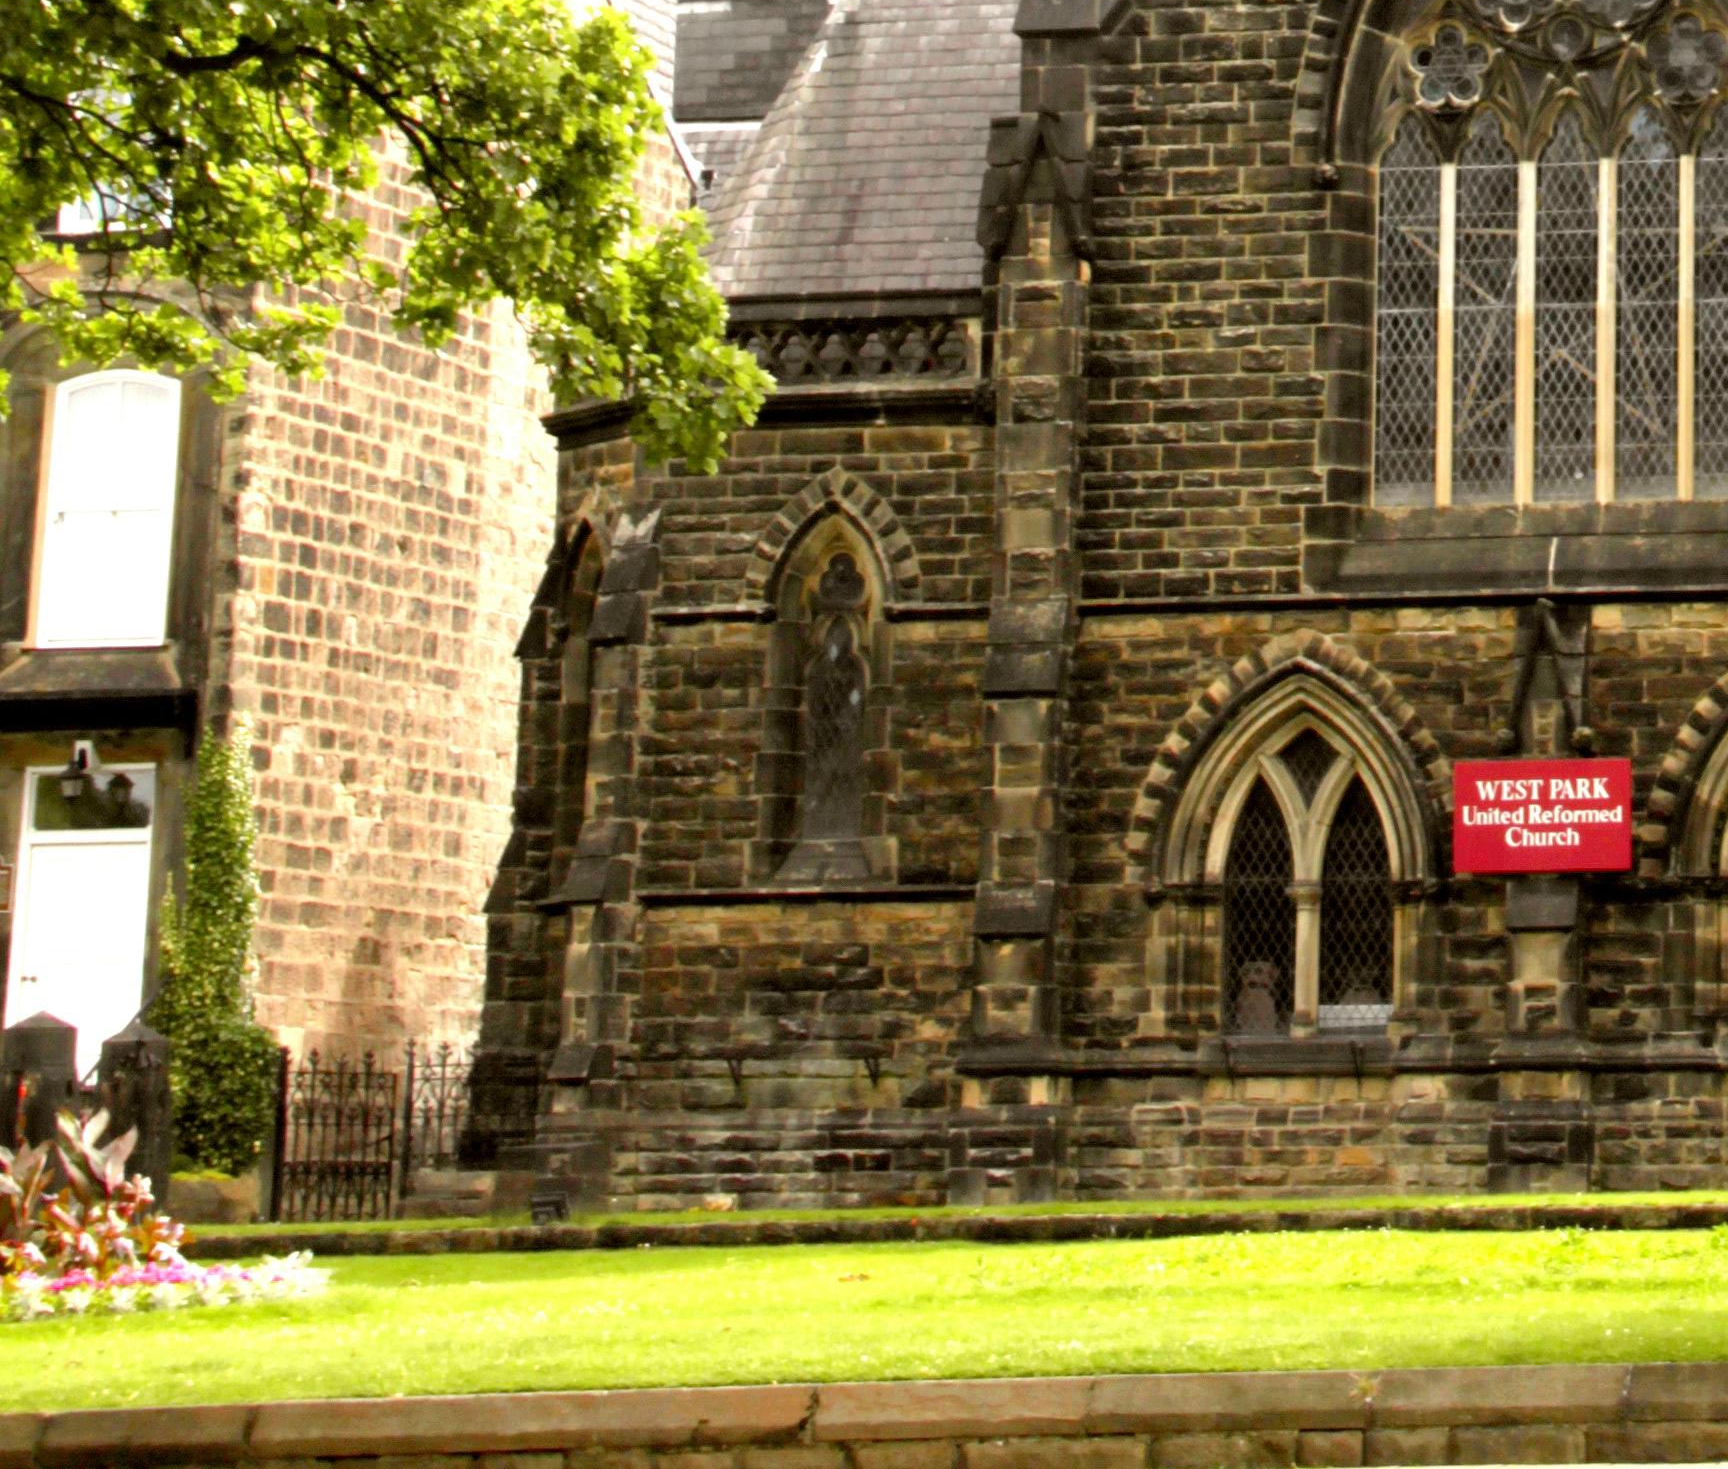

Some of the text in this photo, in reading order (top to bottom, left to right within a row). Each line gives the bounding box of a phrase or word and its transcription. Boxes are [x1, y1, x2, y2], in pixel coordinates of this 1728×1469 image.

[1475, 777, 1609, 801] WEST PARK
[1462, 804, 1622, 826] United Reformed
[1504, 827, 1580, 847] Church
